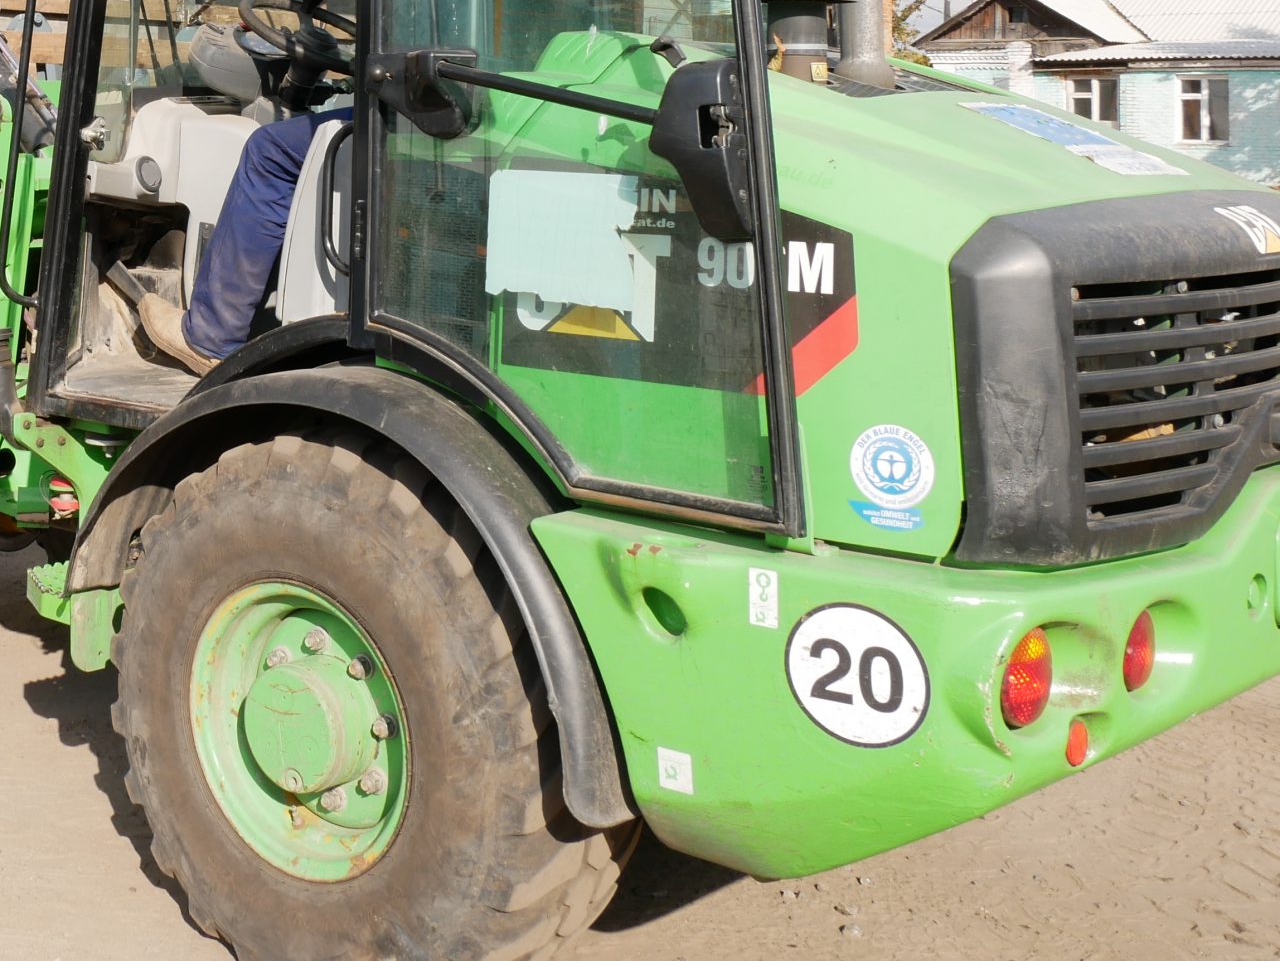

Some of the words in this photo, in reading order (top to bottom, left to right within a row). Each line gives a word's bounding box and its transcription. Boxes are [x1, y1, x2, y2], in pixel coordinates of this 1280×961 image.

[778, 166, 832, 189] au.de
[639, 187, 677, 214] IN
[873, 426, 900, 436] BLAUE
[902, 432, 927, 455] ENGEL
[809, 637, 904, 713] 20
